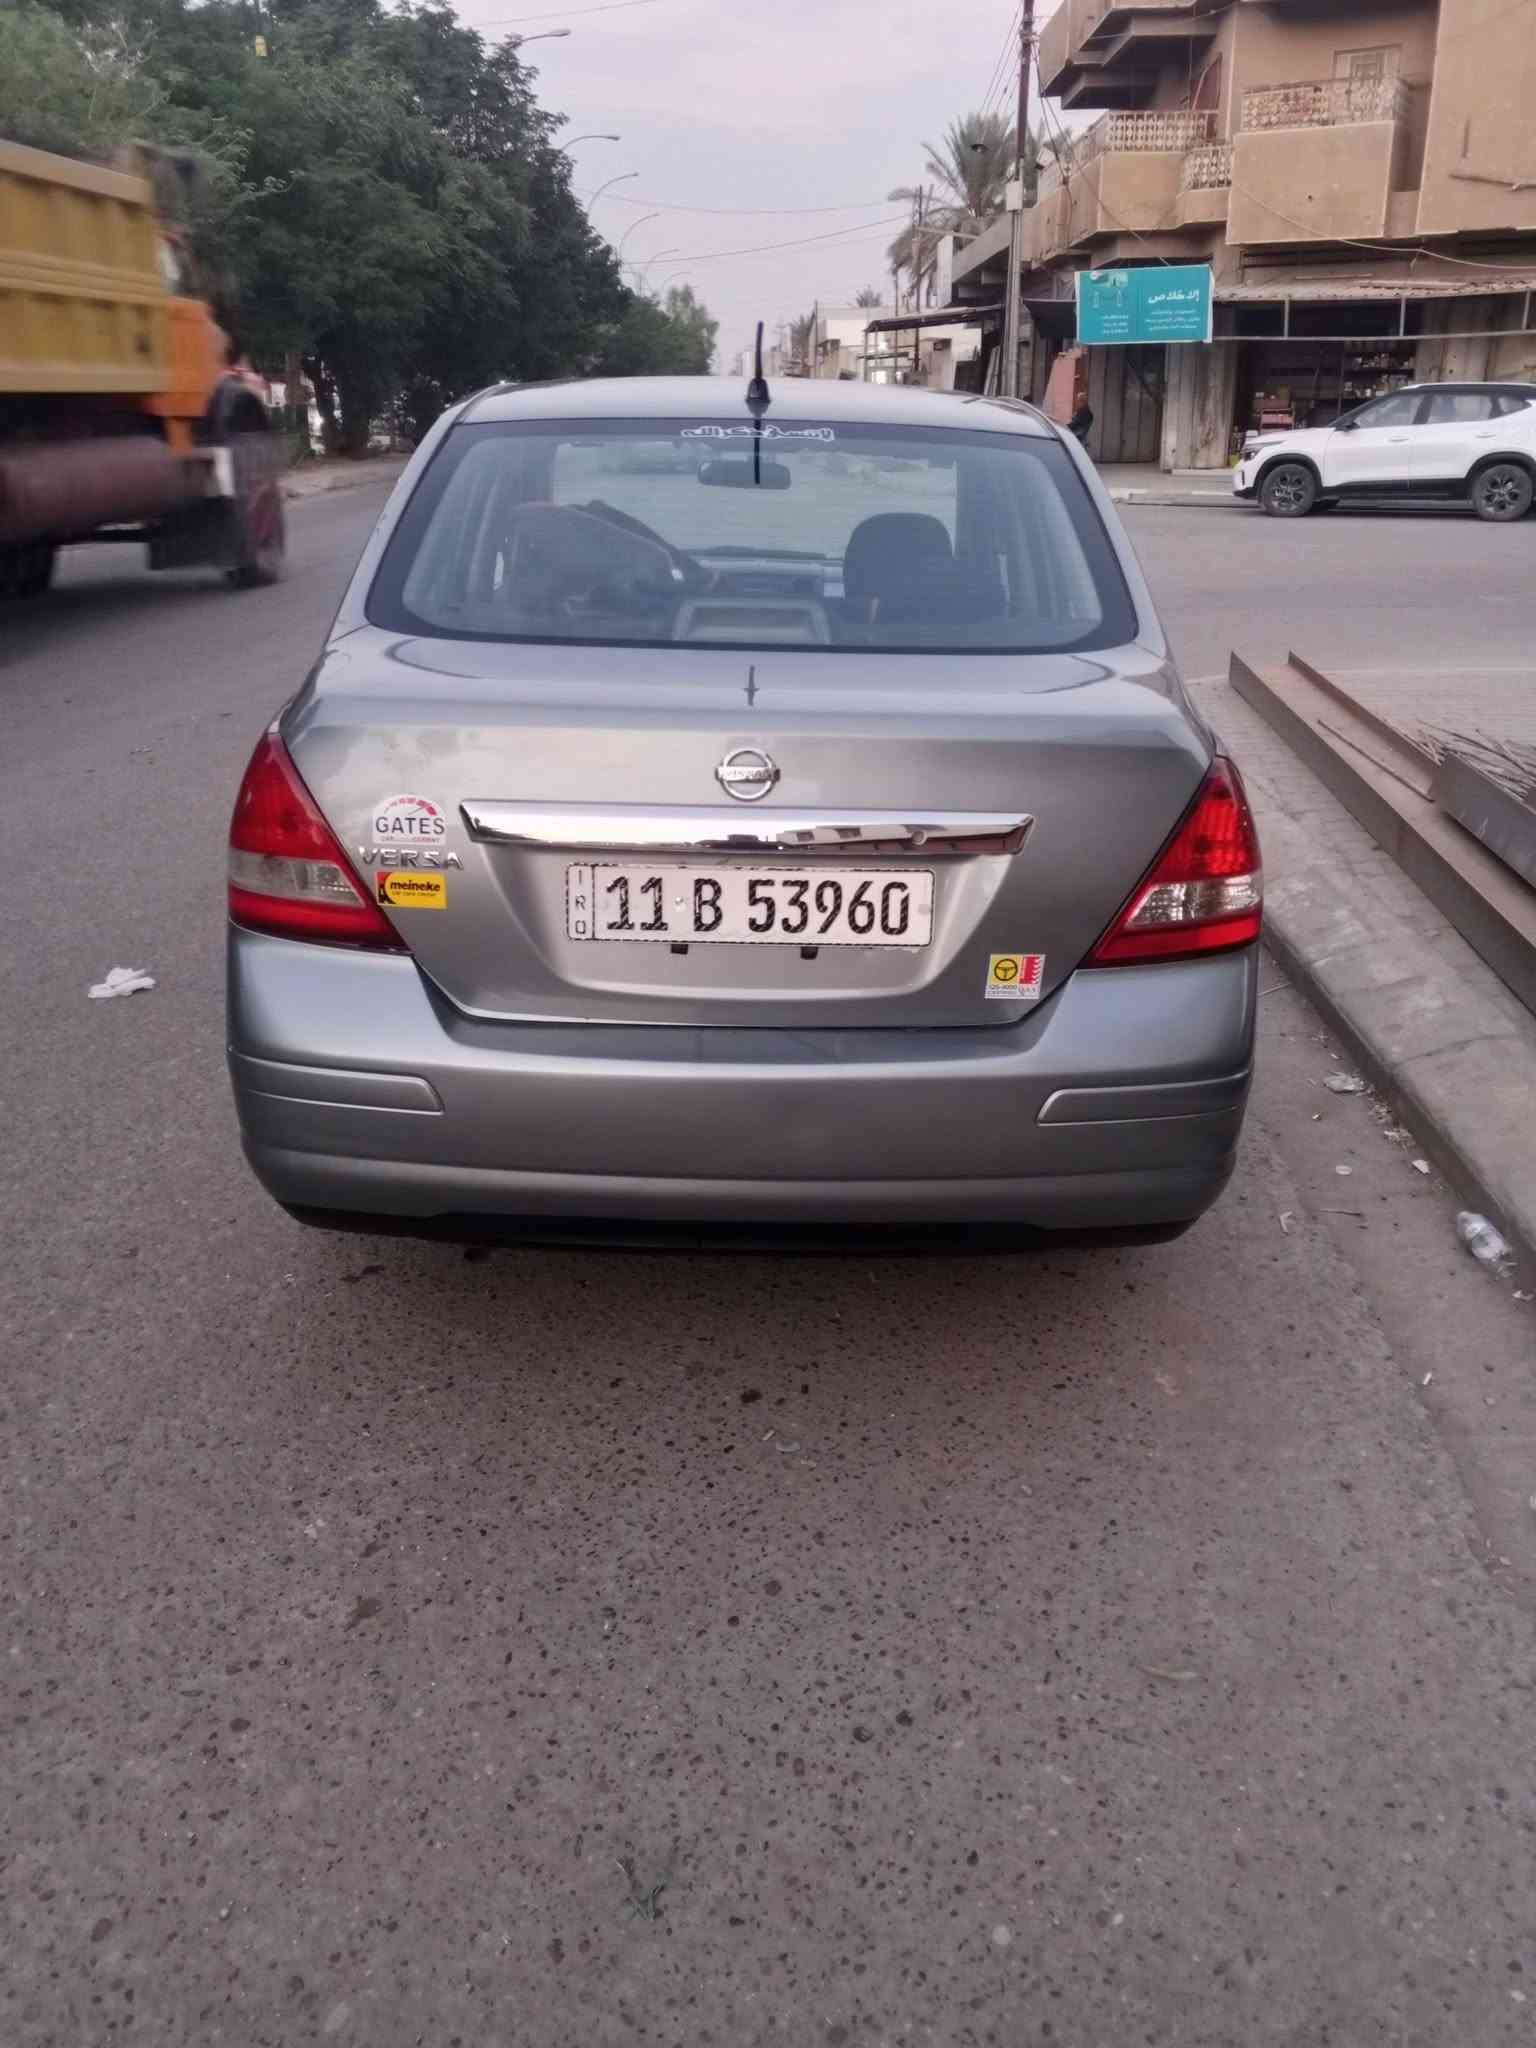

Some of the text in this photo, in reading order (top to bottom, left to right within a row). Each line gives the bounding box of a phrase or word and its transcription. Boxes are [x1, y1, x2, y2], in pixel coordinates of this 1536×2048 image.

[375, 816, 445, 835] GATES
[359, 847, 464, 870] VERSA
[390, 879, 441, 892] meineke
[606, 876, 910, 935] 11 B 53960
